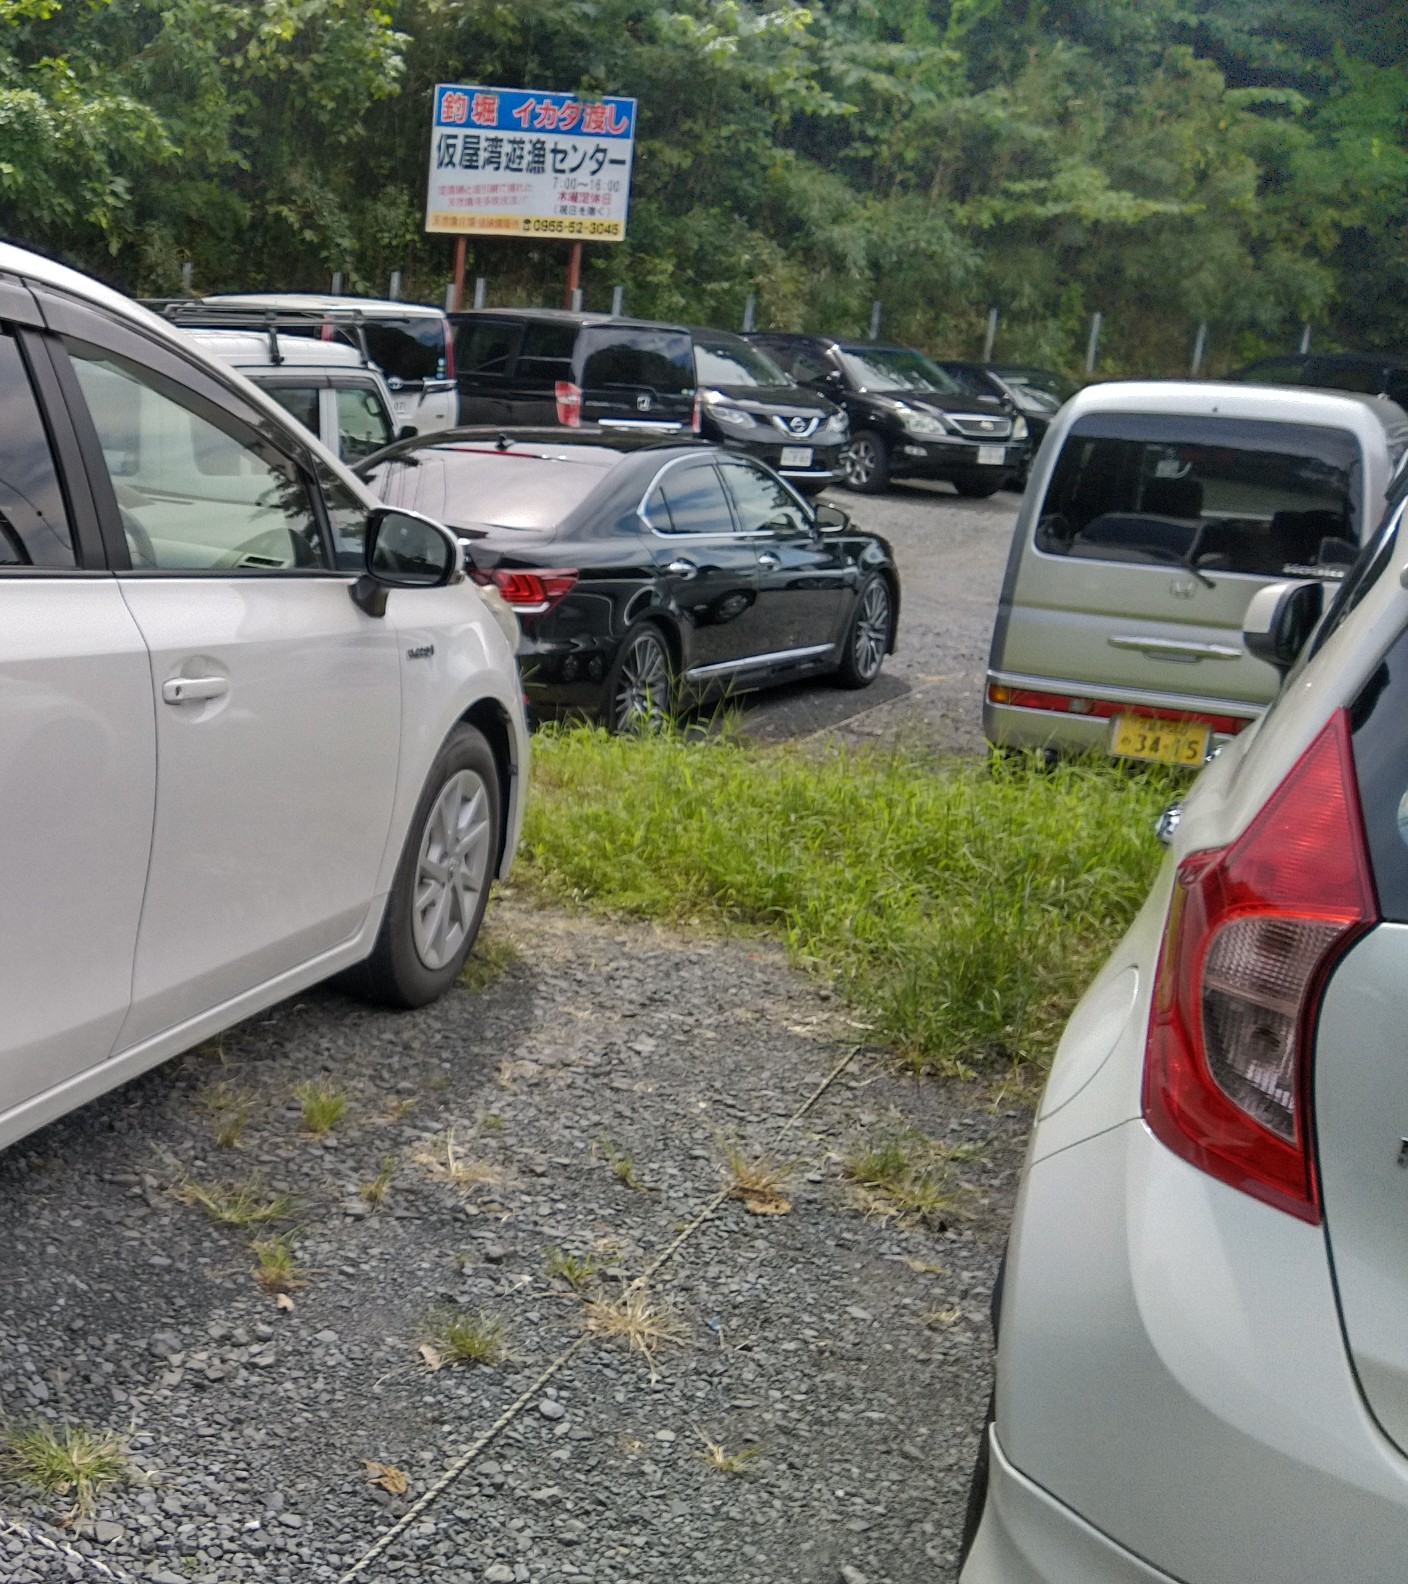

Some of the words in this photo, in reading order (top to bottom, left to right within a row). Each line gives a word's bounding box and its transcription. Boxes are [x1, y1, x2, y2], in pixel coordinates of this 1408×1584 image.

[441, 91, 498, 126] 釣堀
[512, 98, 629, 134] イカダ渡し
[437, 133, 626, 176] 仮屋湾遊漁センター
